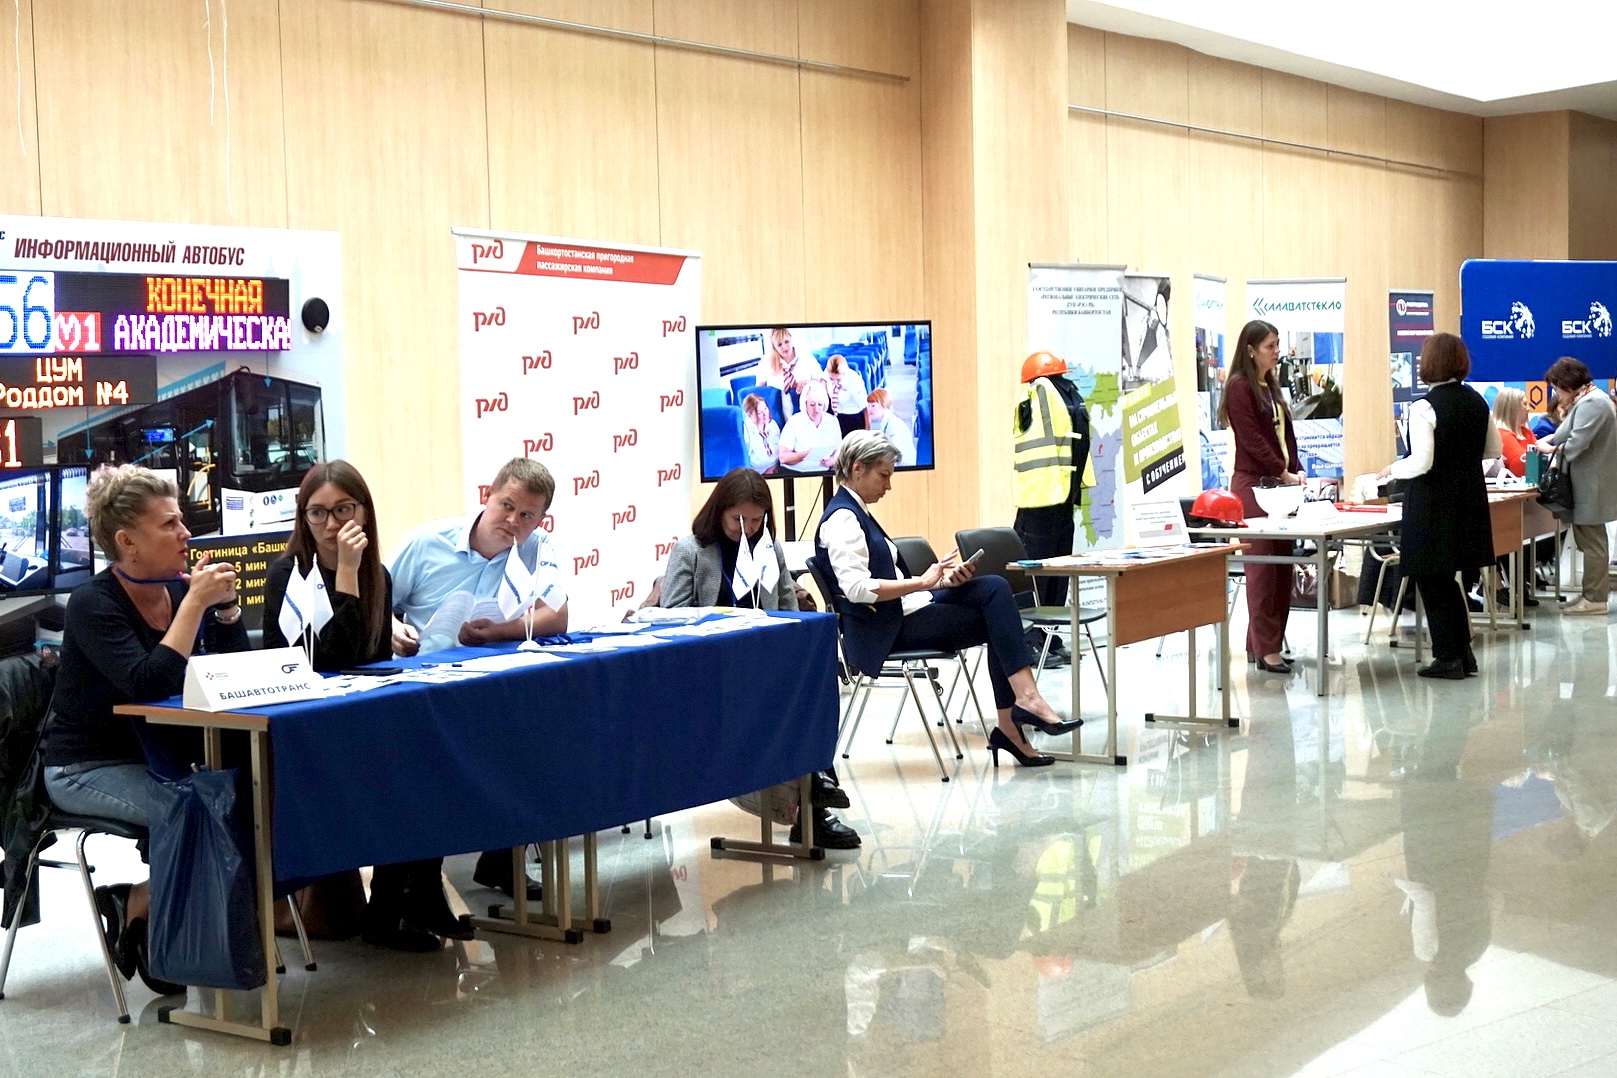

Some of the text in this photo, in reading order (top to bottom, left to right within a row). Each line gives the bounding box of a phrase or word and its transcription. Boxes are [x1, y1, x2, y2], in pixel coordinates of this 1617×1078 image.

[14, 238, 245, 266] ИНФОРМАЦИОННЫЙ АВТОБУС
[537, 244, 595, 258] Башкортостанская
[583, 265, 613, 275] компания
[146, 277, 264, 314] КОНЕЧНАЯ
[114, 314, 292, 351] АКАДЕМИЧЕСКА
[1482, 320, 1514, 334] БСК
[1561, 320, 1592, 334] БСК
[36, 357, 83, 383] ЦУМ
[96, 380, 129, 406] №4
[1151, 452, 1186, 482] ОБУЧЕНИЕ
[245, 561, 267, 572] мин
[235, 578, 242, 590] 2
[219, 682, 311, 700] БАШАВТОТРАНС
